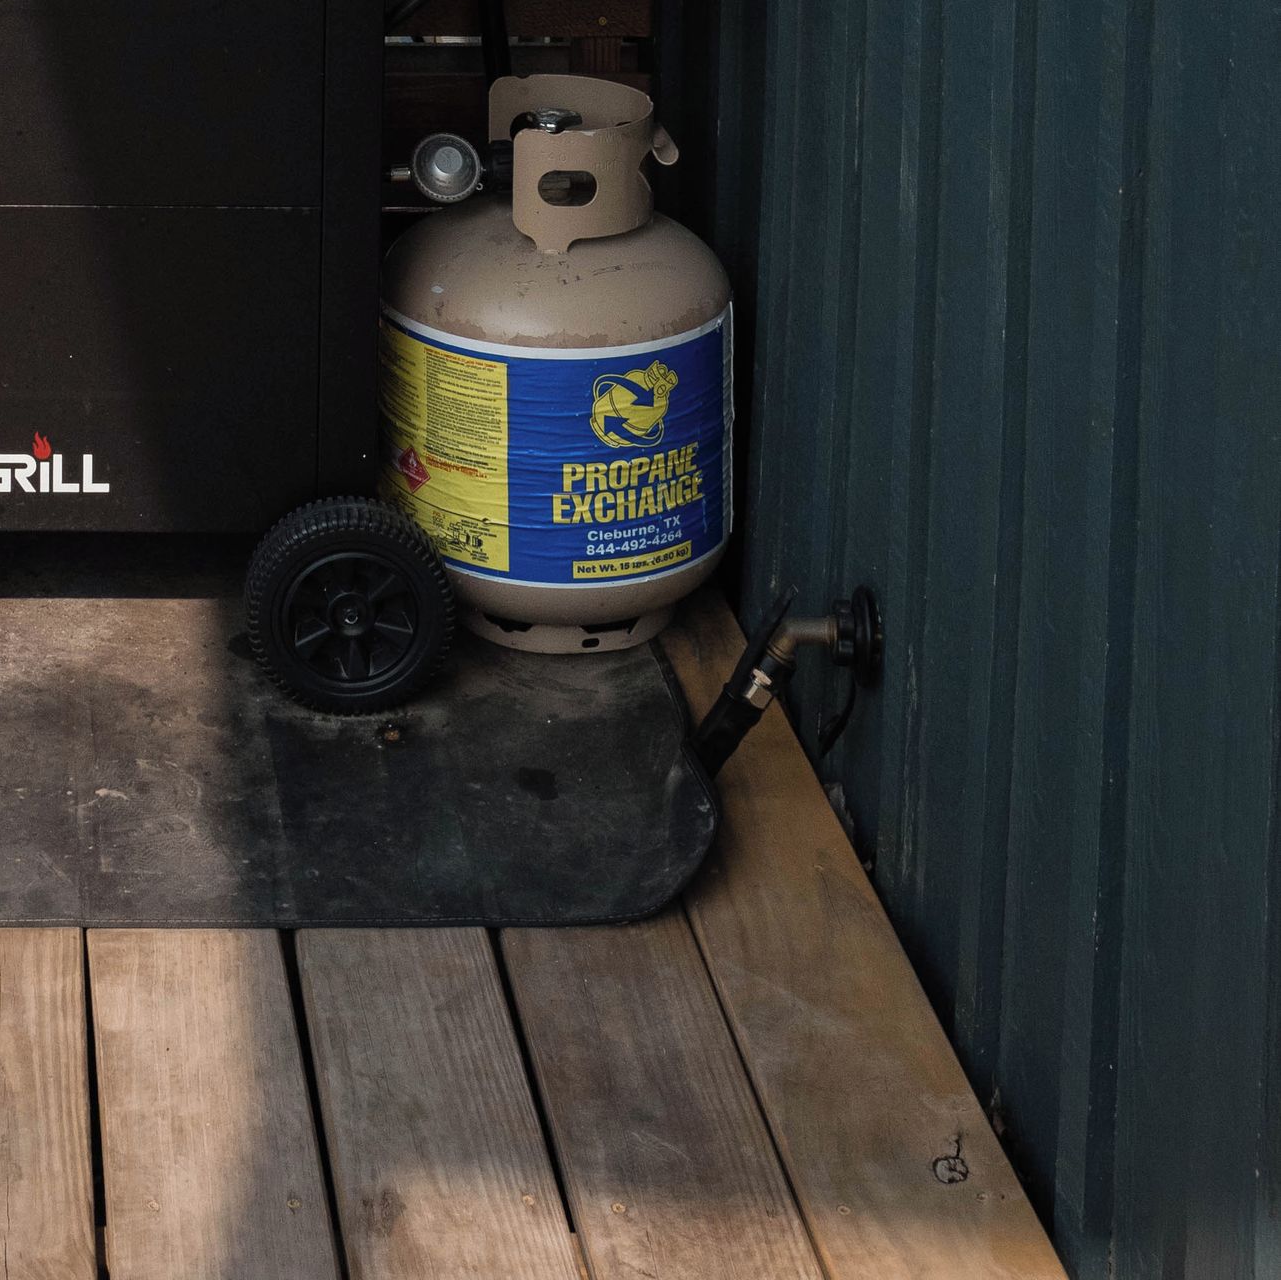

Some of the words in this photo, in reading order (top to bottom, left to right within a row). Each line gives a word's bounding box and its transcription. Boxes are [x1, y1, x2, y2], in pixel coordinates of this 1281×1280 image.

[562, 441, 700, 492] PROPANE
[552, 469, 705, 524] EXCHANGE
[586, 528, 683, 556] 844-492-4264
[587, 523, 660, 542] Cleburne,
[663, 515, 681, 529] TX
[576, 564, 597, 574] Net
[599, 562, 617, 573] Wt.
[620, 561, 630, 571] 15
[676, 546, 690, 560] kg)
